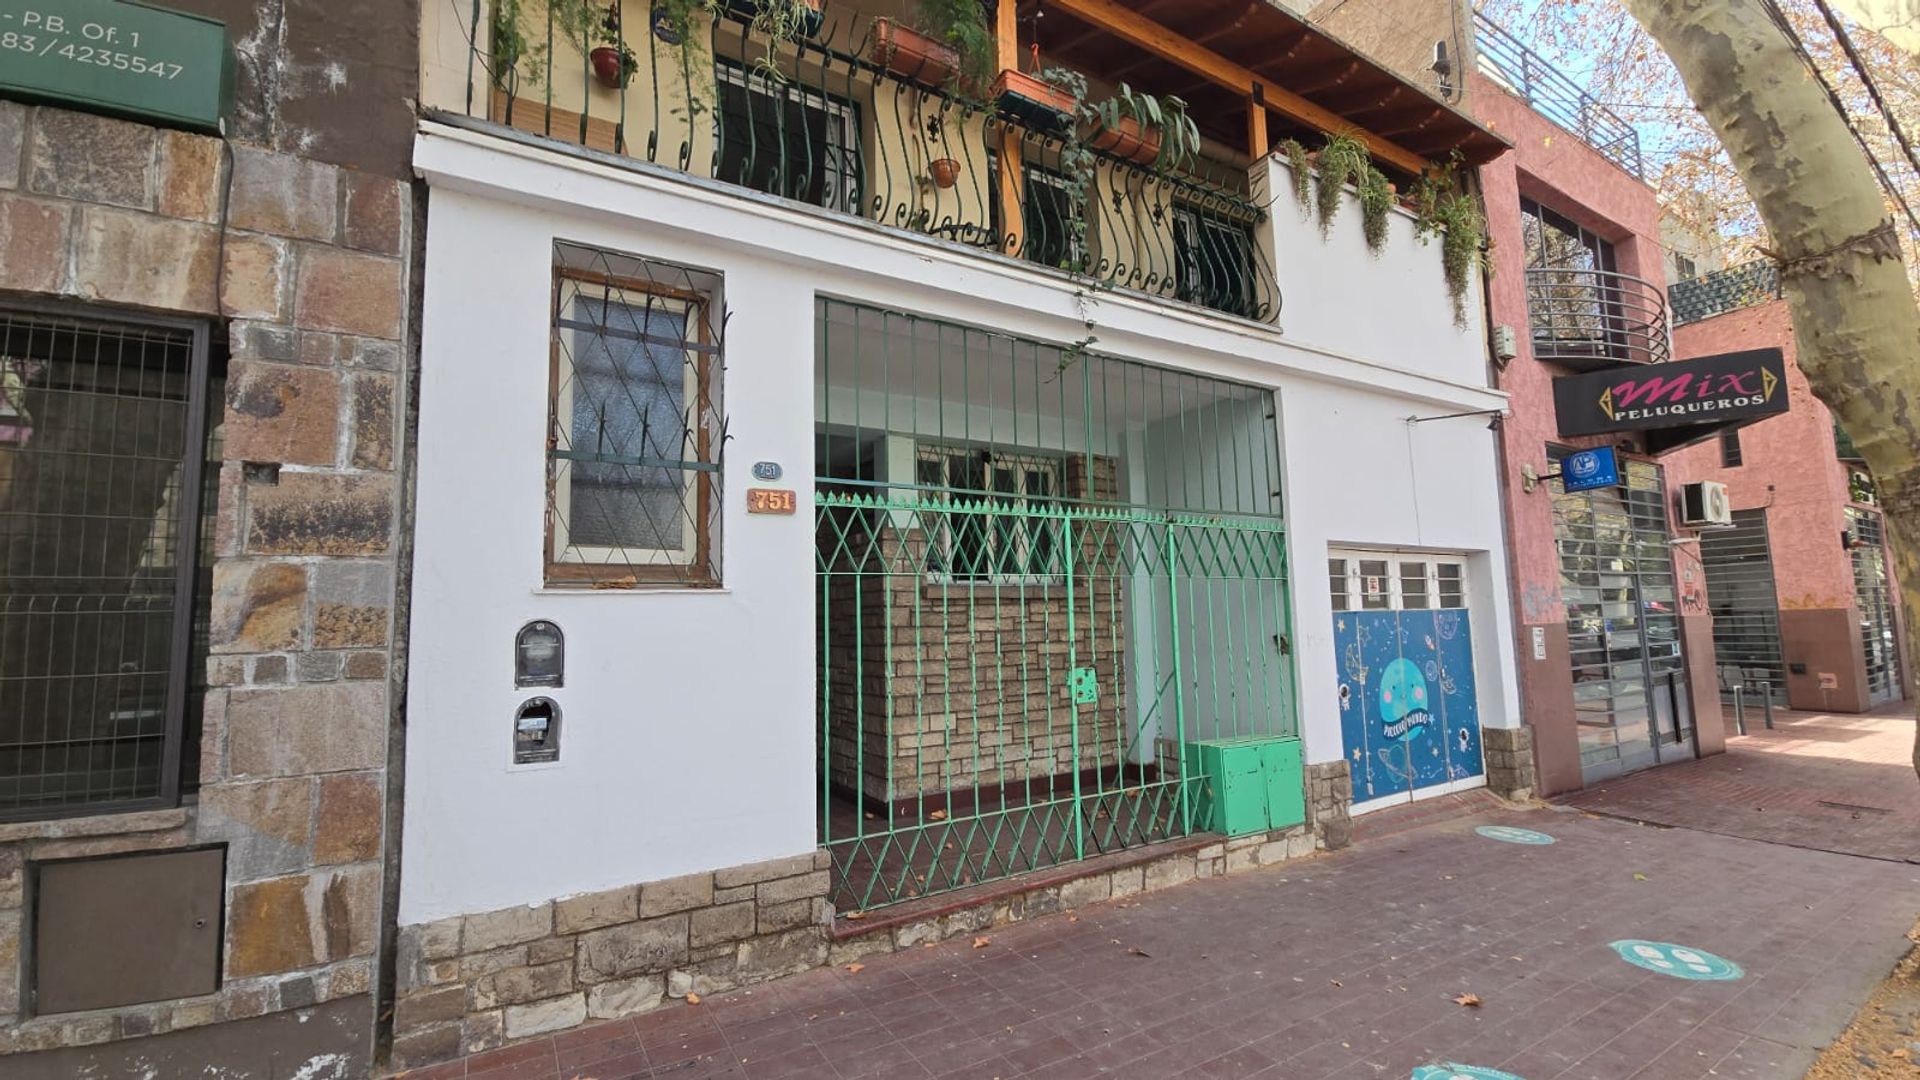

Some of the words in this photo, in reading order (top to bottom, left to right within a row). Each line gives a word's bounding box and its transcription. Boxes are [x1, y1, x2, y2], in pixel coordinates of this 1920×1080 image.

[23, 11, 70, 34] P.B.
[82, 23, 119, 44] Of.
[130, 32, 139, 47] 1
[1614, 394, 1765, 421] PELUQUEROS
[759, 463, 776, 476] 751
[755, 491, 791, 510] 751
